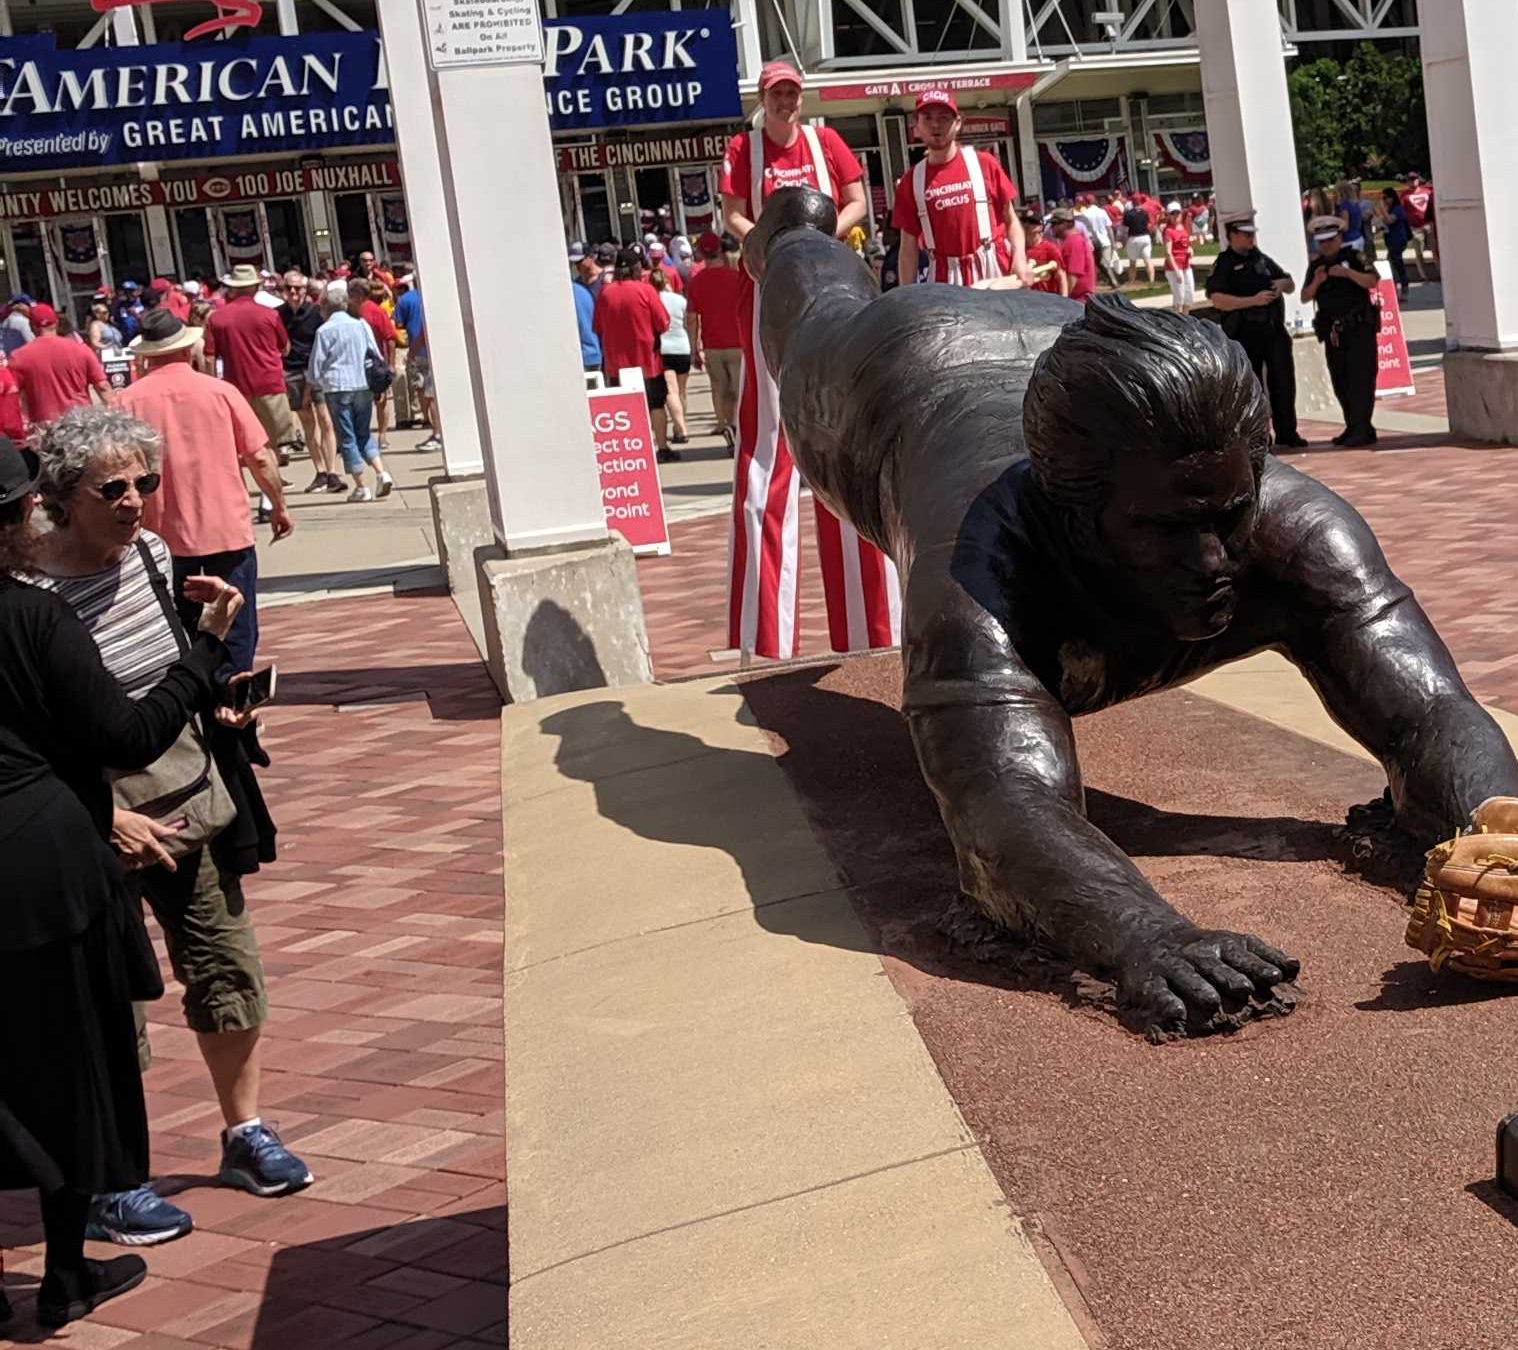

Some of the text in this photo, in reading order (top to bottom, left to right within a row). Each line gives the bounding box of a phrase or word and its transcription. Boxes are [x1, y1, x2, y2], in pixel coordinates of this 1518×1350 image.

[448, 6, 531, 19] Skating & Cycling
[451, 18, 532, 30] ARE PROHIBITED
[480, 33, 493, 41] On
[454, 42, 536, 55] Ballpark Property
[1, 53, 343, 116] AMERICAN
[543, 25, 699, 78] PARK
[865, 85, 889, 95] GATE
[890, 82, 901, 96] A
[950, 78, 991, 88] TERRACE
[88, 129, 111, 155] by
[123, 115, 224, 148] GREAT
[606, 80, 703, 113] GROUP
[49, 183, 153, 213] WELCOMES
[160, 179, 198, 202] YOU
[235, 173, 269, 197] 100
[275, 169, 304, 193] JOE
[311, 163, 393, 190] NUXHALL
[570, 146, 600, 167] THE
[606, 138, 699, 166] CINCINNATI
[934, 193, 970, 211] CIRCUS
[1378, 357, 1401, 370] oint
[592, 411, 631, 433] GS
[623, 437, 643, 450] to
[596, 456, 647, 475] ection
[603, 502, 650, 521] Point
